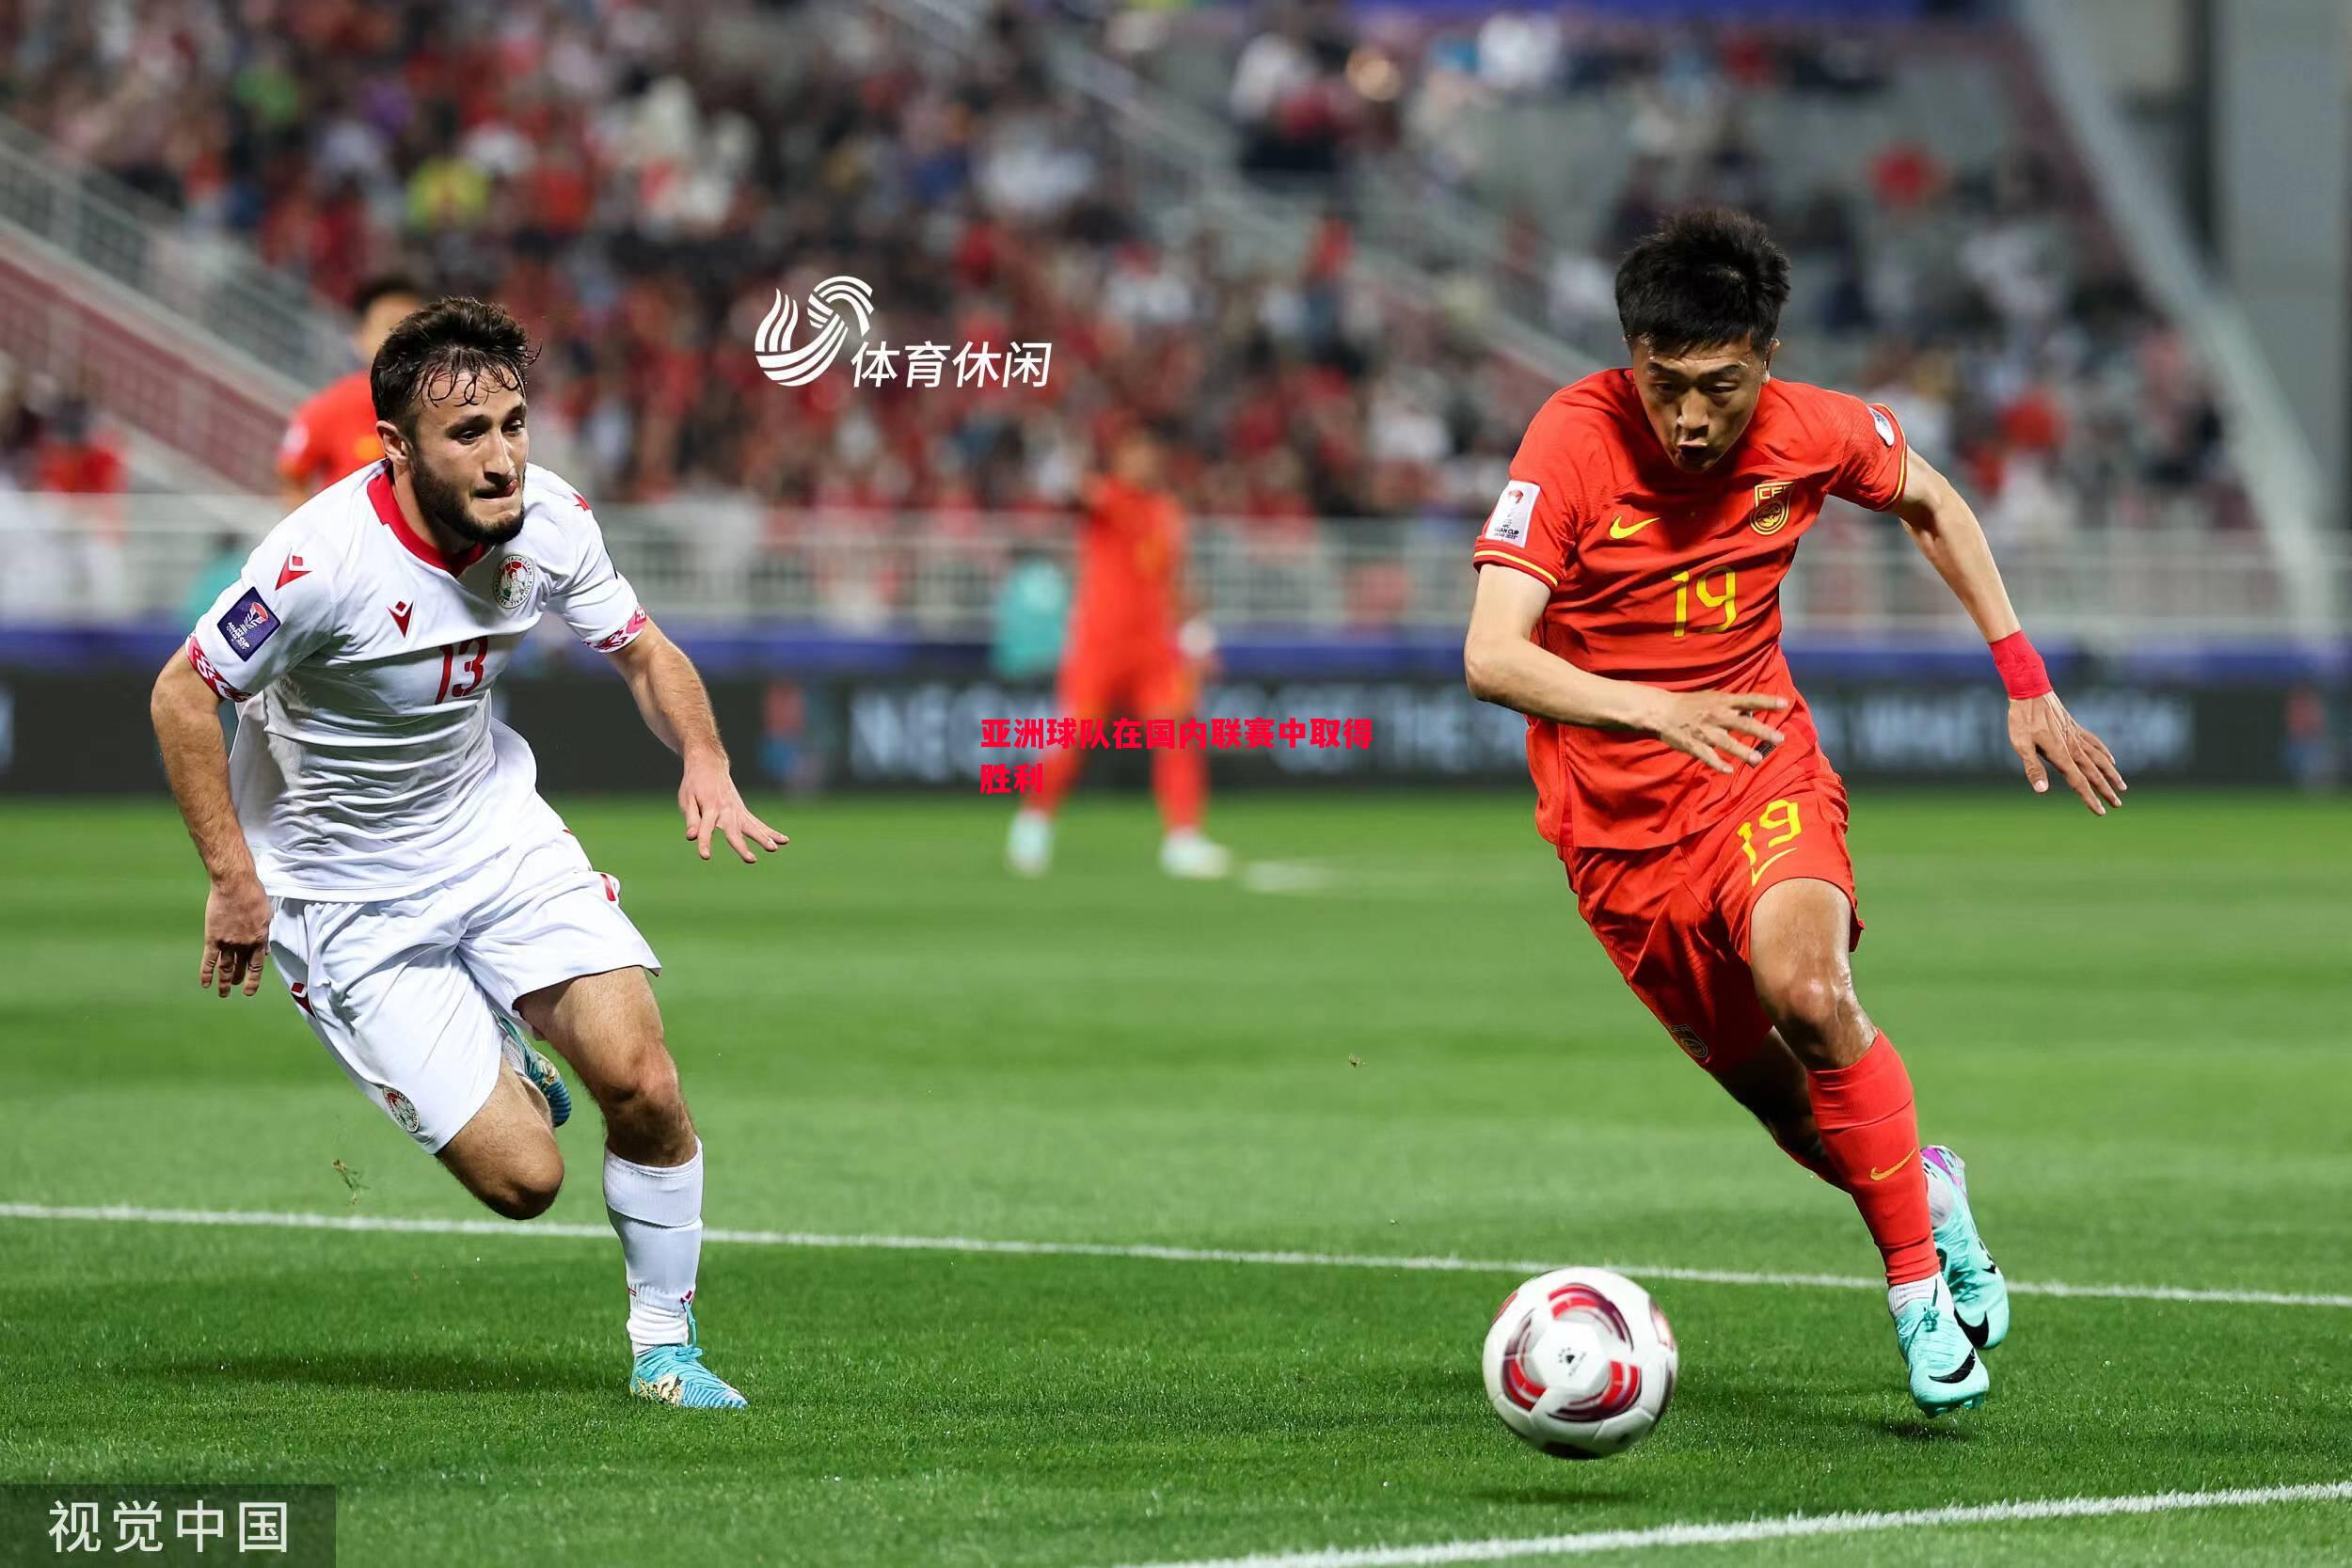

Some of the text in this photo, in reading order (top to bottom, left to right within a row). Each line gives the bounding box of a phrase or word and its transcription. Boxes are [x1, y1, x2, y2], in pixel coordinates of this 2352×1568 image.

[1671, 565, 1737, 638] 19
[435, 635, 489, 705] 13
[1737, 799, 1803, 866] 19
